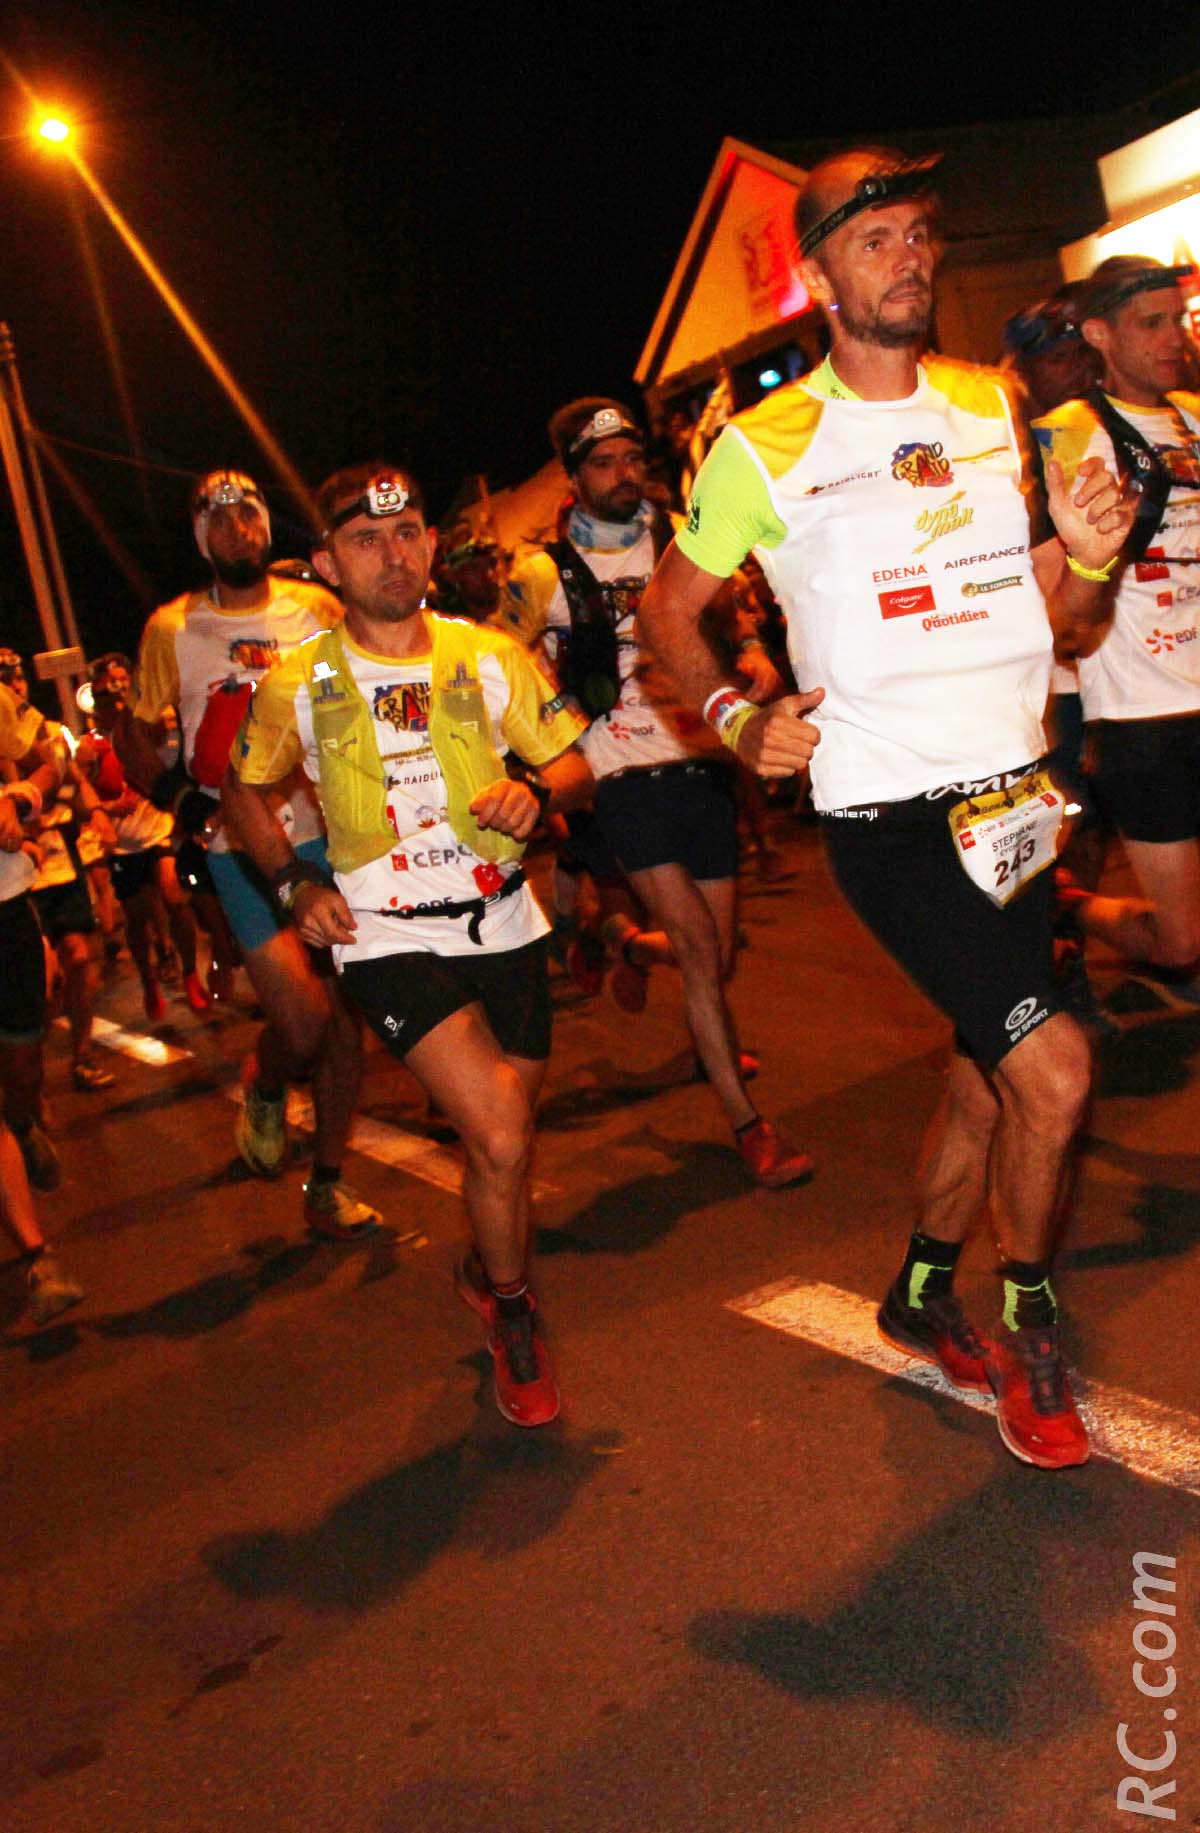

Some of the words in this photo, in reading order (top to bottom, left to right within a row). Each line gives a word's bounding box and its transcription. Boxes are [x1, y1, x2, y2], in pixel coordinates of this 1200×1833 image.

[872, 563, 928, 583] EDENA
[922, 609, 989, 632] Quotidien
[994, 839, 1036, 887] 243
